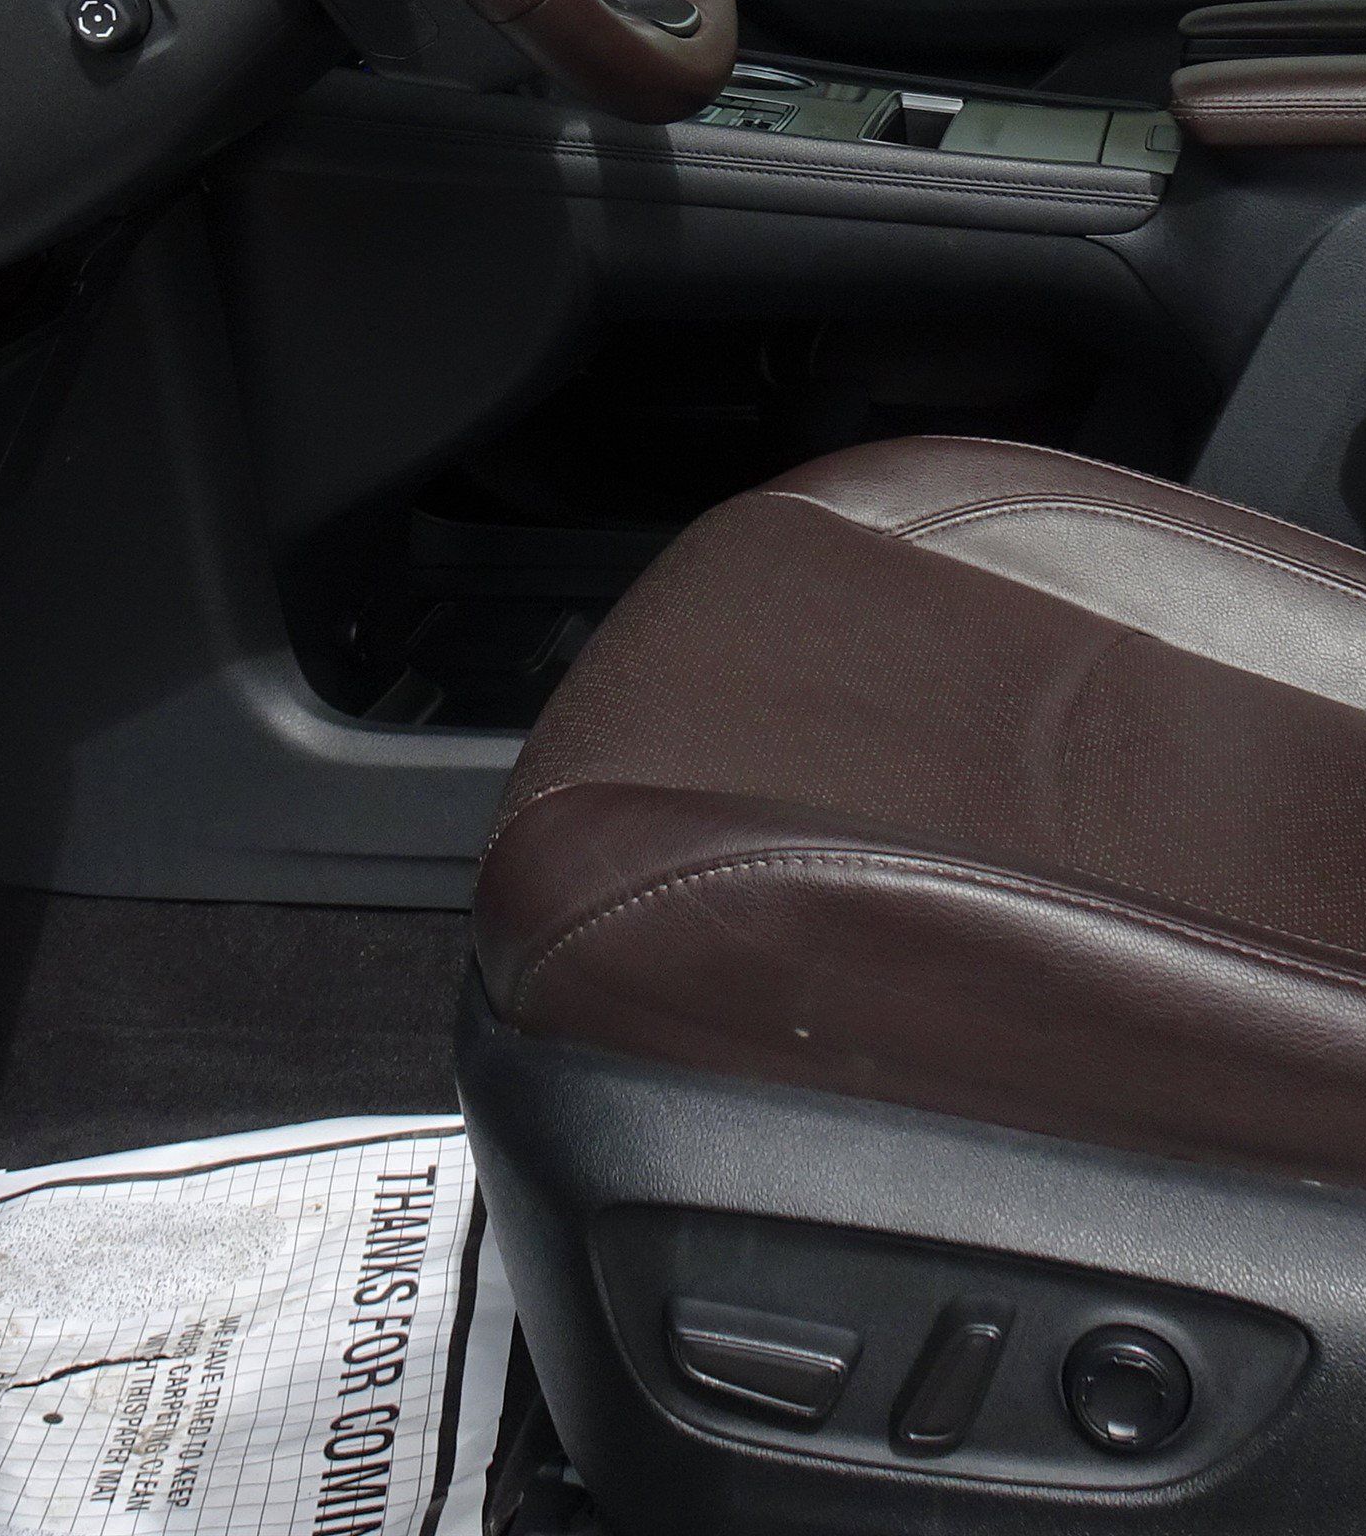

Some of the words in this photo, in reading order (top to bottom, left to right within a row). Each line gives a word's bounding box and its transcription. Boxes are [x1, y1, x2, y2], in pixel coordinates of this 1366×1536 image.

[353, 1165, 436, 1309] THANKS
[173, 1318, 209, 1358] YOUR
[214, 1315, 241, 1337] WE
[201, 1338, 233, 1384] HAVE
[337, 1313, 415, 1397] FOR
[124, 1375, 155, 1415] THIS
[145, 1364, 192, 1453] CARPETING
[187, 1387, 221, 1436] TRIED
[104, 1417, 142, 1465] PAPER
[179, 1440, 208, 1460] TO
[90, 1469, 123, 1503] MAT
[125, 1459, 164, 1512] CLEAN
[167, 1465, 199, 1507] KEEP
